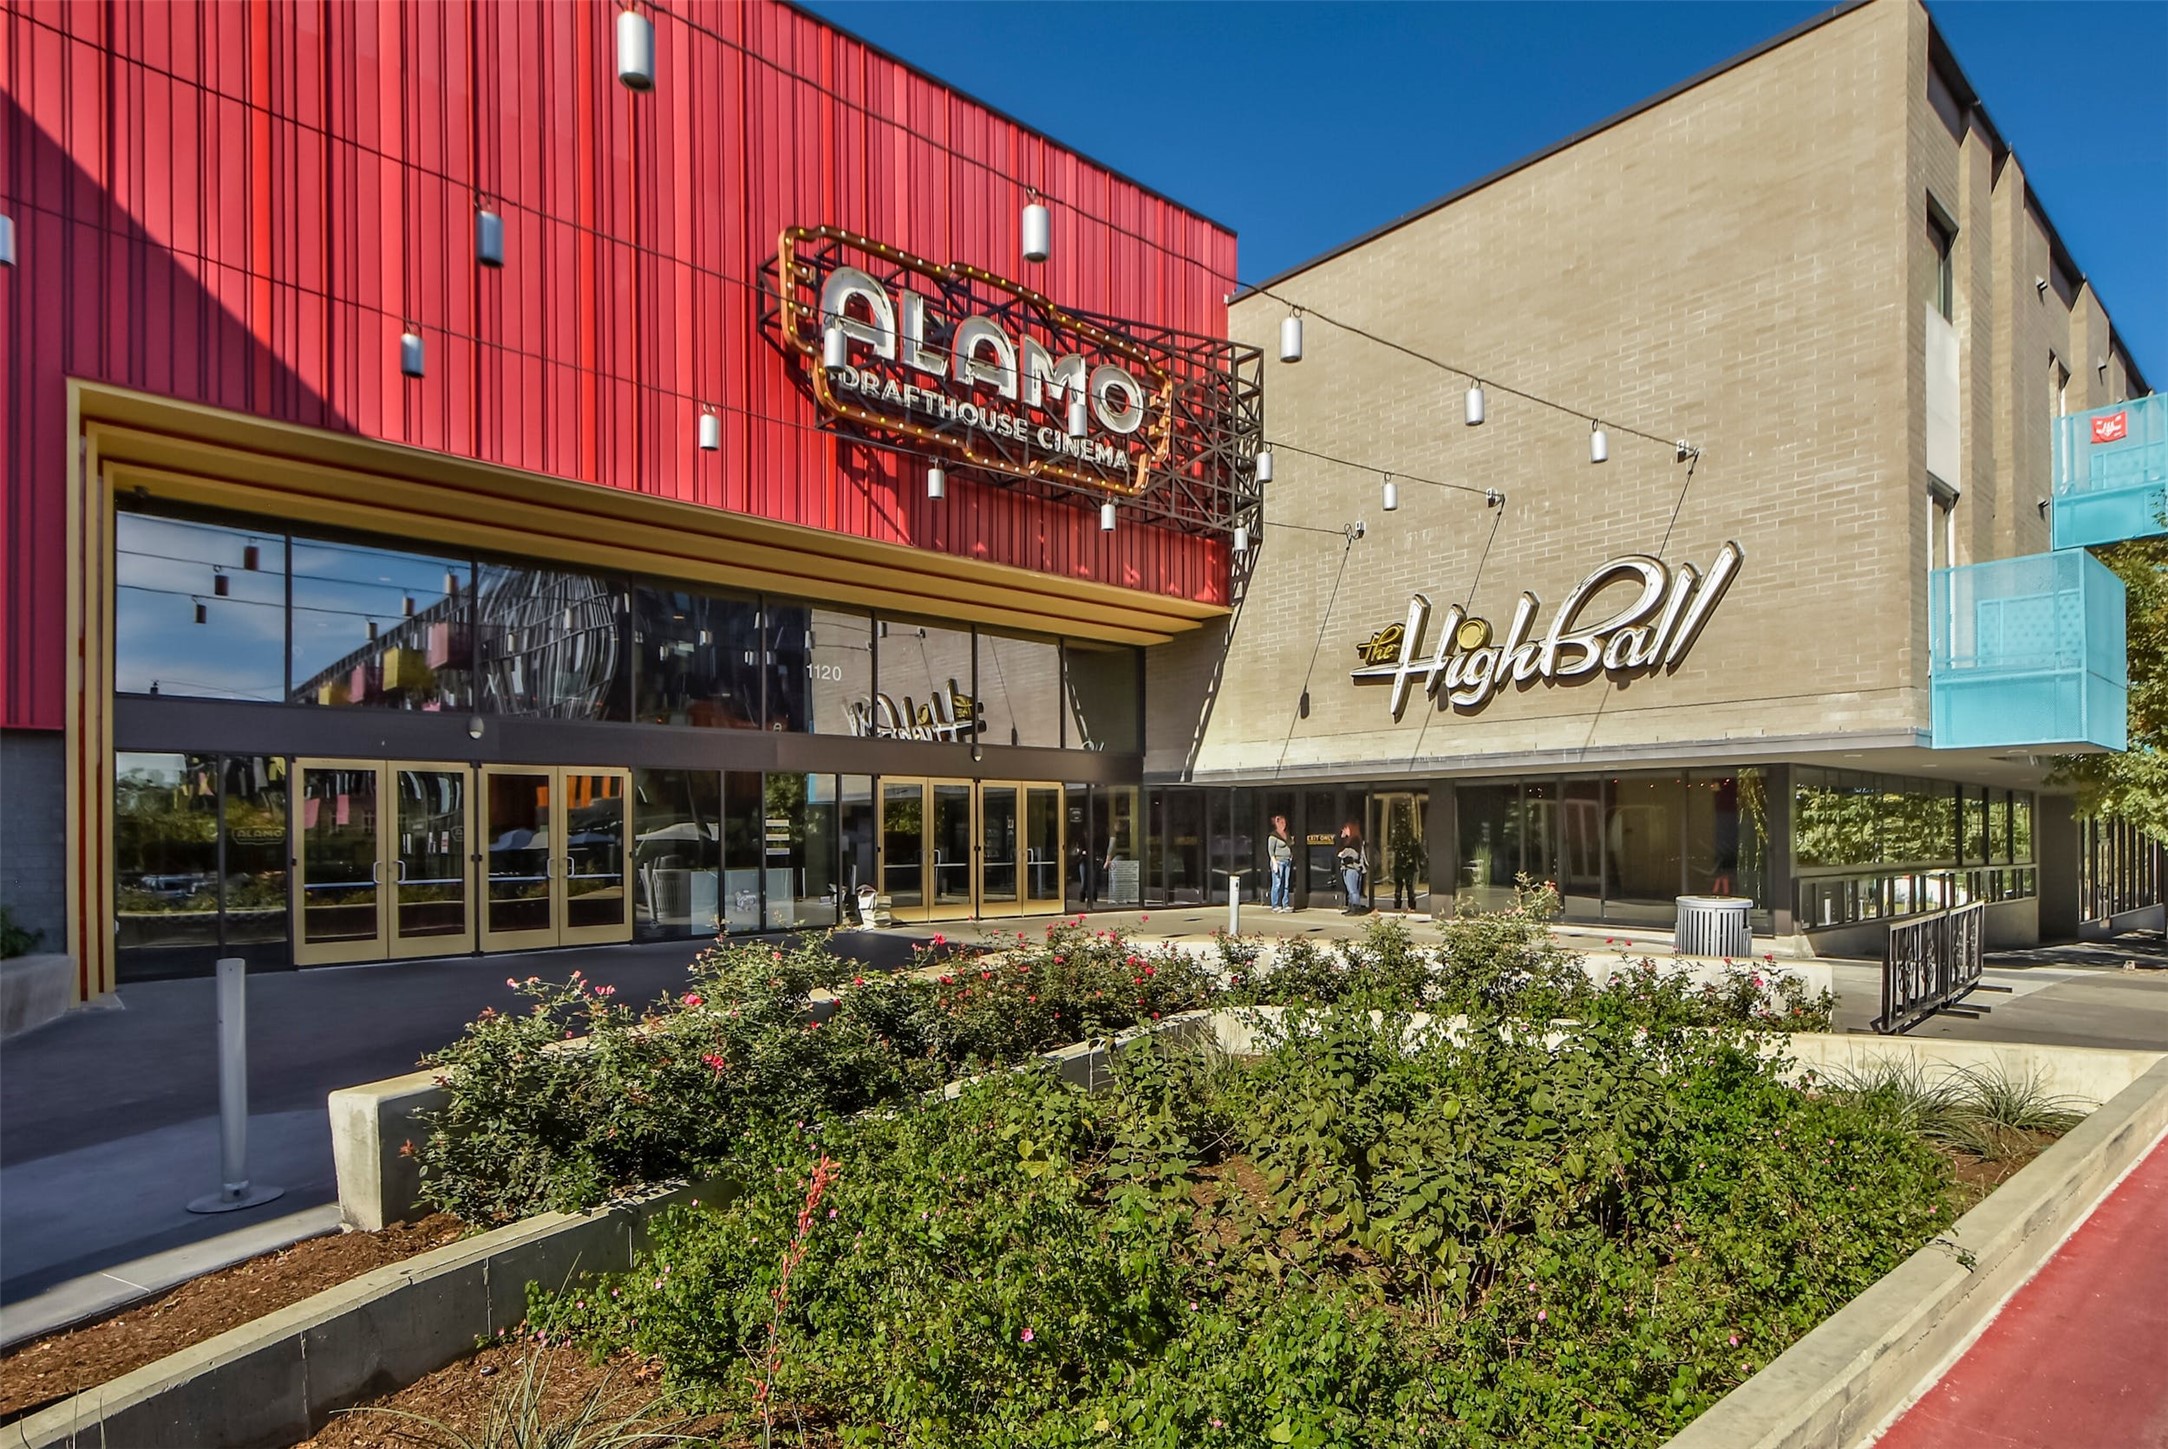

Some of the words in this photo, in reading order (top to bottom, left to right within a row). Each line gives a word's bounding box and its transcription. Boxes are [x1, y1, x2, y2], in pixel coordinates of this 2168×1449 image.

[822, 266, 1144, 434] ALAMO
[838, 366, 1029, 441] DRAFTHOUSE
[1037, 427, 1129, 469] CINEMA
[806, 663, 842, 681] 1120
